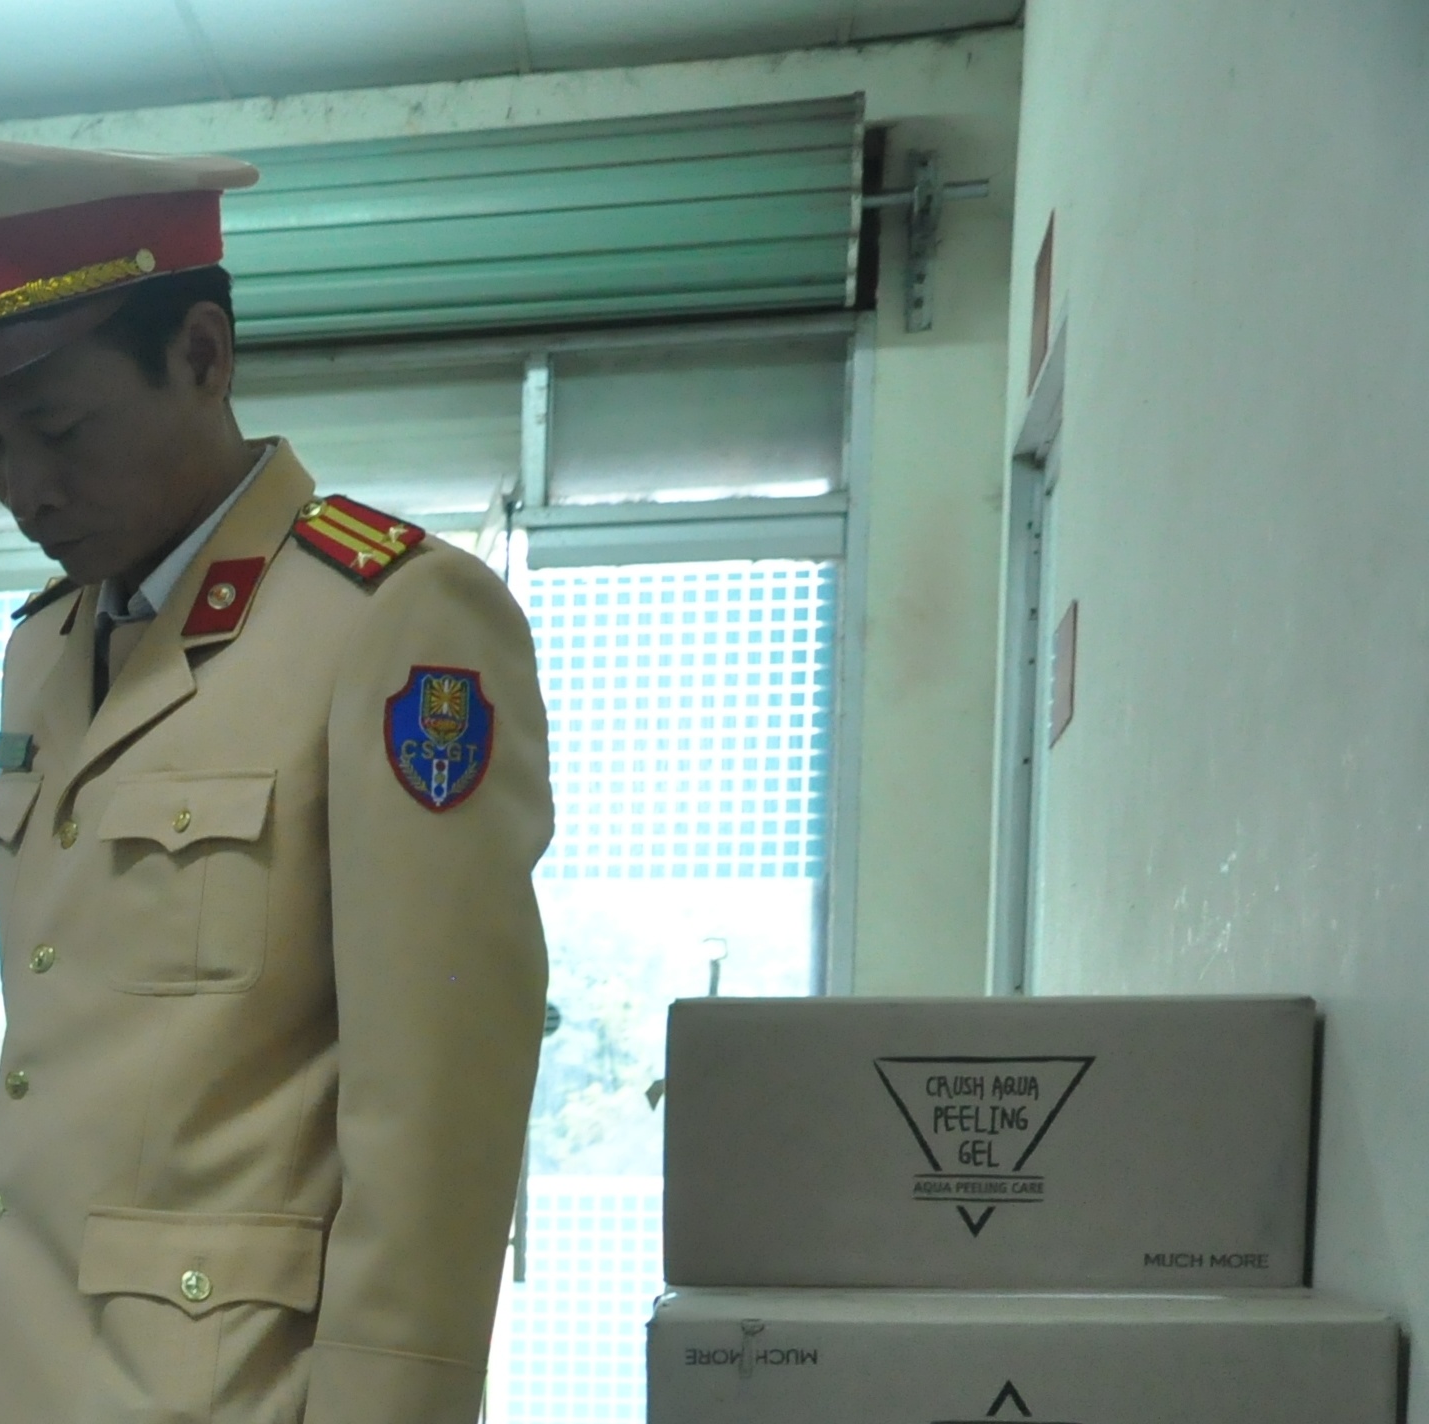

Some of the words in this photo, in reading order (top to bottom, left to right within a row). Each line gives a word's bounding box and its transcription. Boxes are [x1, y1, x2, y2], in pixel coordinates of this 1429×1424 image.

[925, 1075, 984, 1100] CRUSH
[992, 1075, 1039, 1100] AQUA
[933, 1105, 1028, 1134] PEELING
[958, 1139, 1000, 1168] GEL
[913, 1181, 952, 1194] AQUA
[956, 1182, 1008, 1194] PEELING
[1011, 1182, 1044, 1194] CARE
[1143, 1253, 1203, 1268] MUCH
[1209, 1253, 1270, 1269] MORE
[755, 1348, 818, 1366] MUCH
